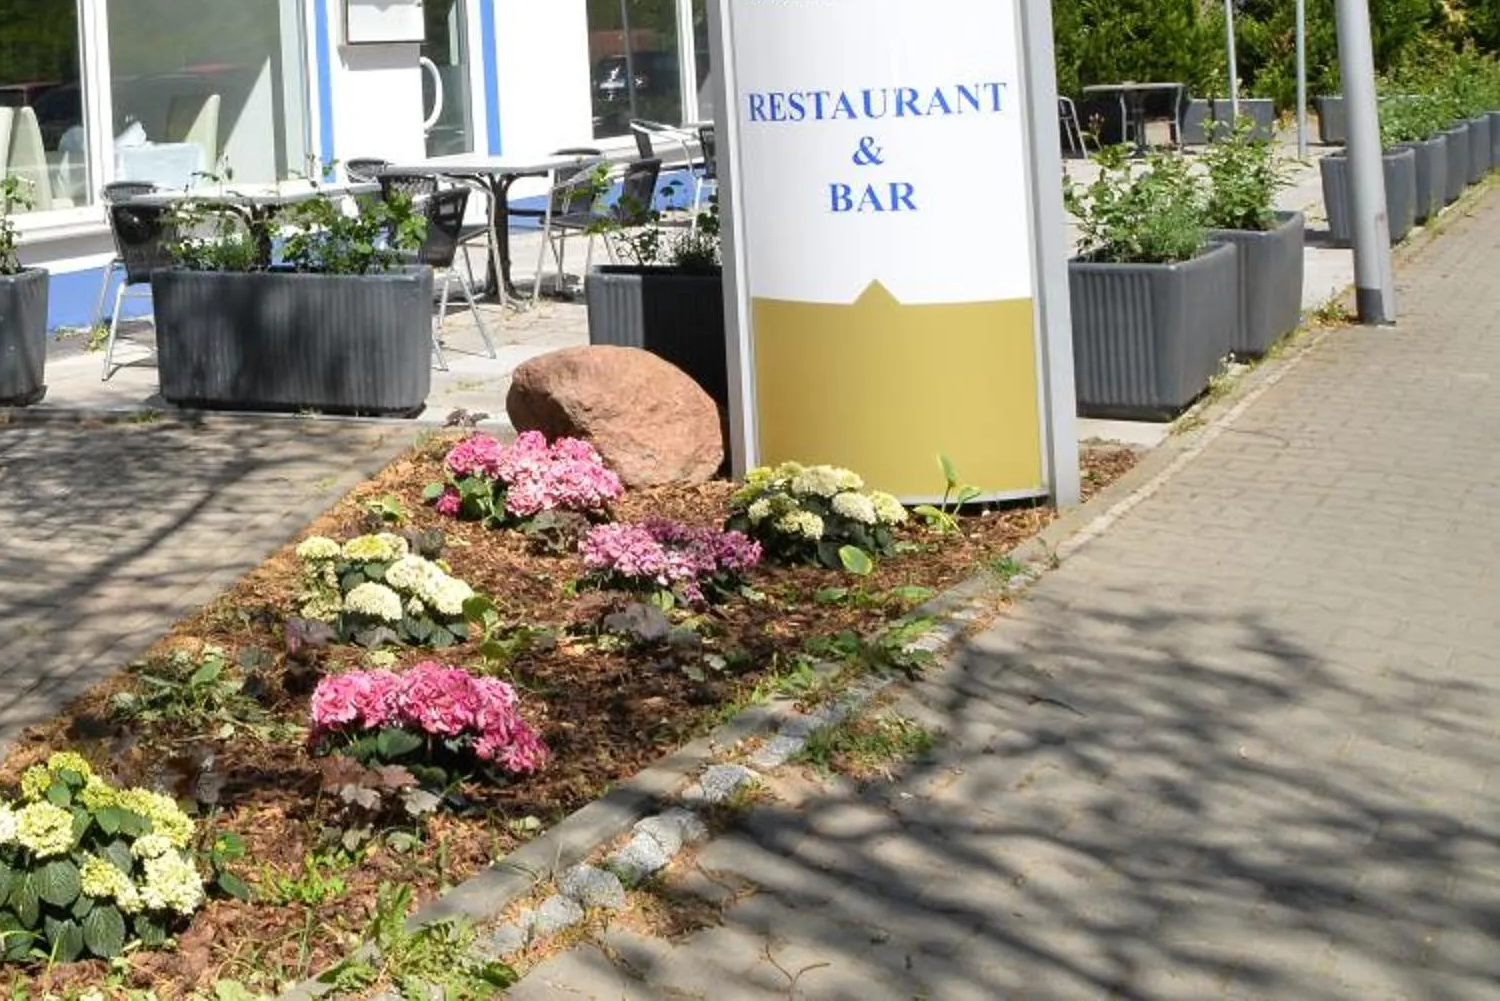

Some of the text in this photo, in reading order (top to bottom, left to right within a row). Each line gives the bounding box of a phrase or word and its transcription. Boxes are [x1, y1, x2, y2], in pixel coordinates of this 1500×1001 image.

[748, 81, 1007, 122] RESTAURANT
[852, 136, 885, 166] &
[829, 182, 918, 213] BAR
